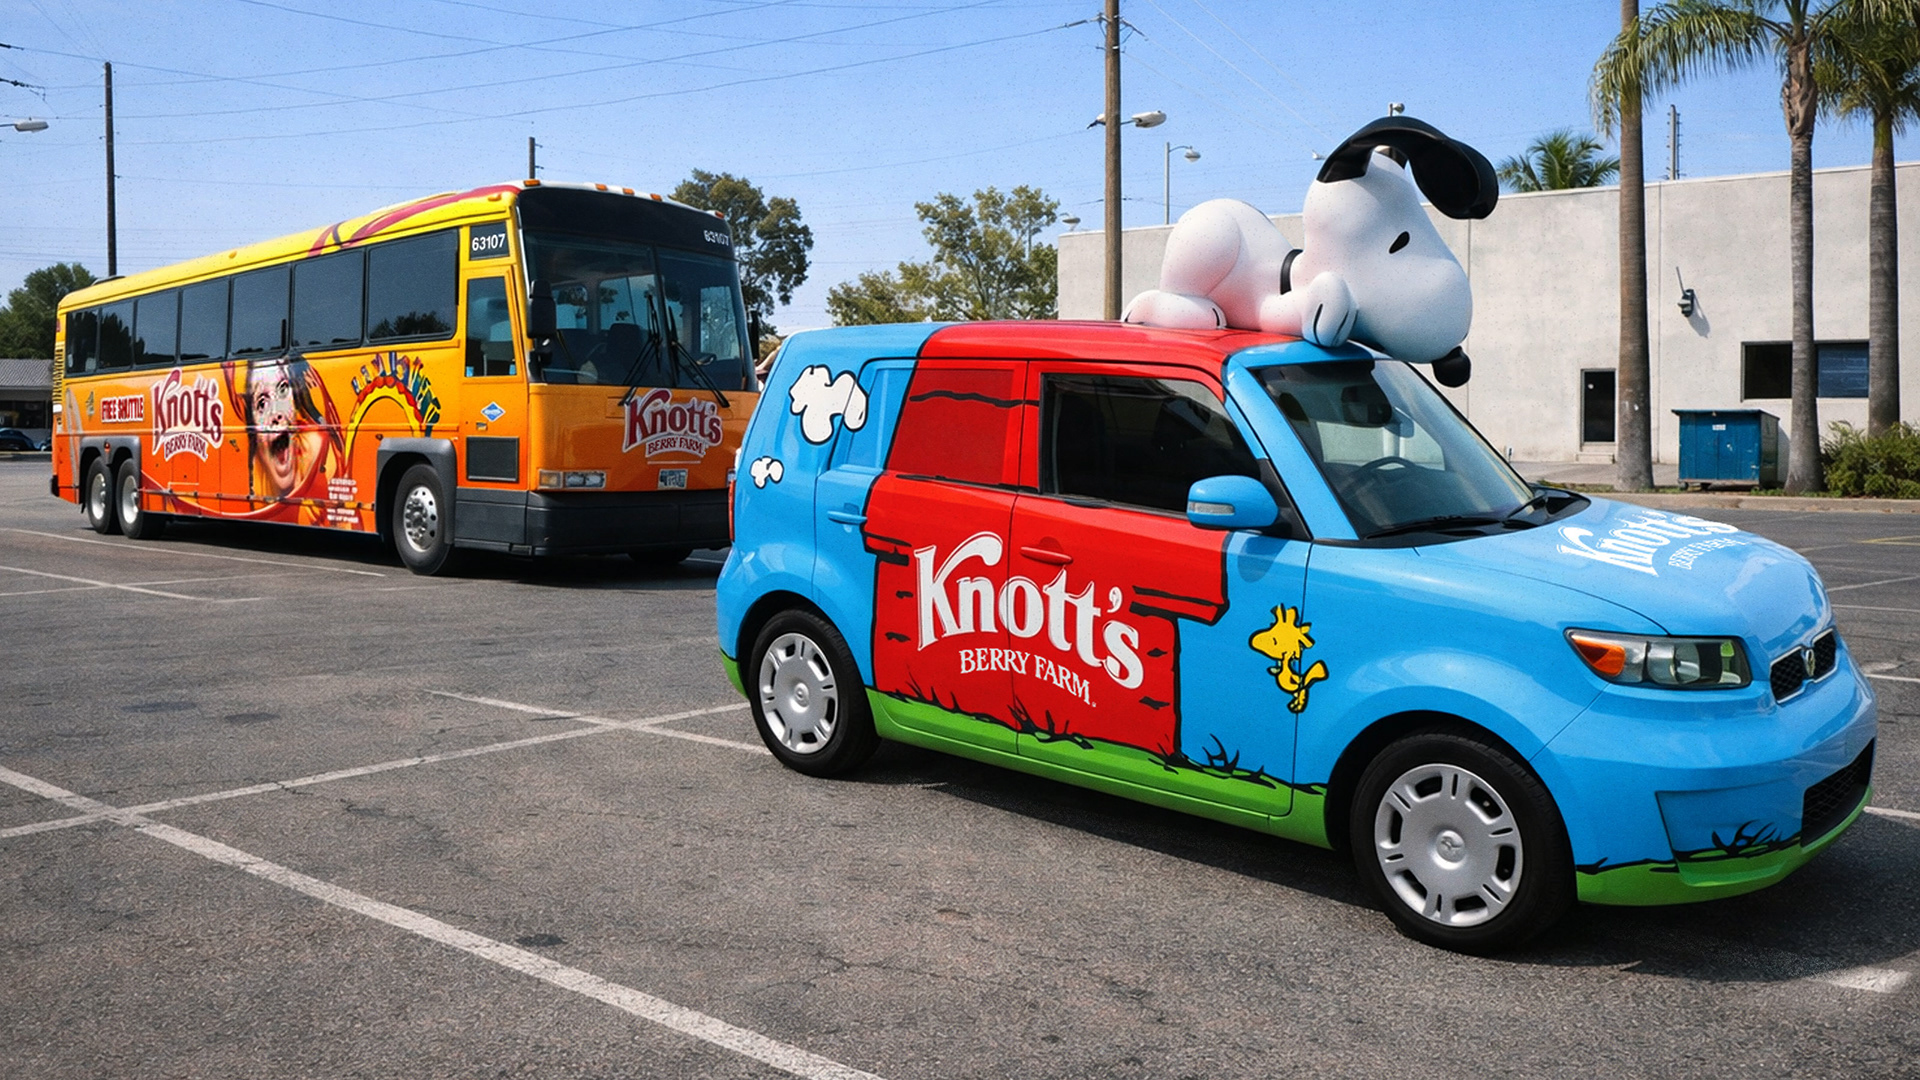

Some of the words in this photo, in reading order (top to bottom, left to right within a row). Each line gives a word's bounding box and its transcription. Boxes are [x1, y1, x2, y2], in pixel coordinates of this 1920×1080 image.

[472, 233, 506, 251] 63107
[153, 369, 222, 452] Knott's
[624, 388, 722, 450] Knott's
[648, 436, 678, 454] BERRY
[914, 531, 1144, 690] Knott's
[959, 647, 1030, 675] BERRY
[1033, 654, 1091, 706] FARM
